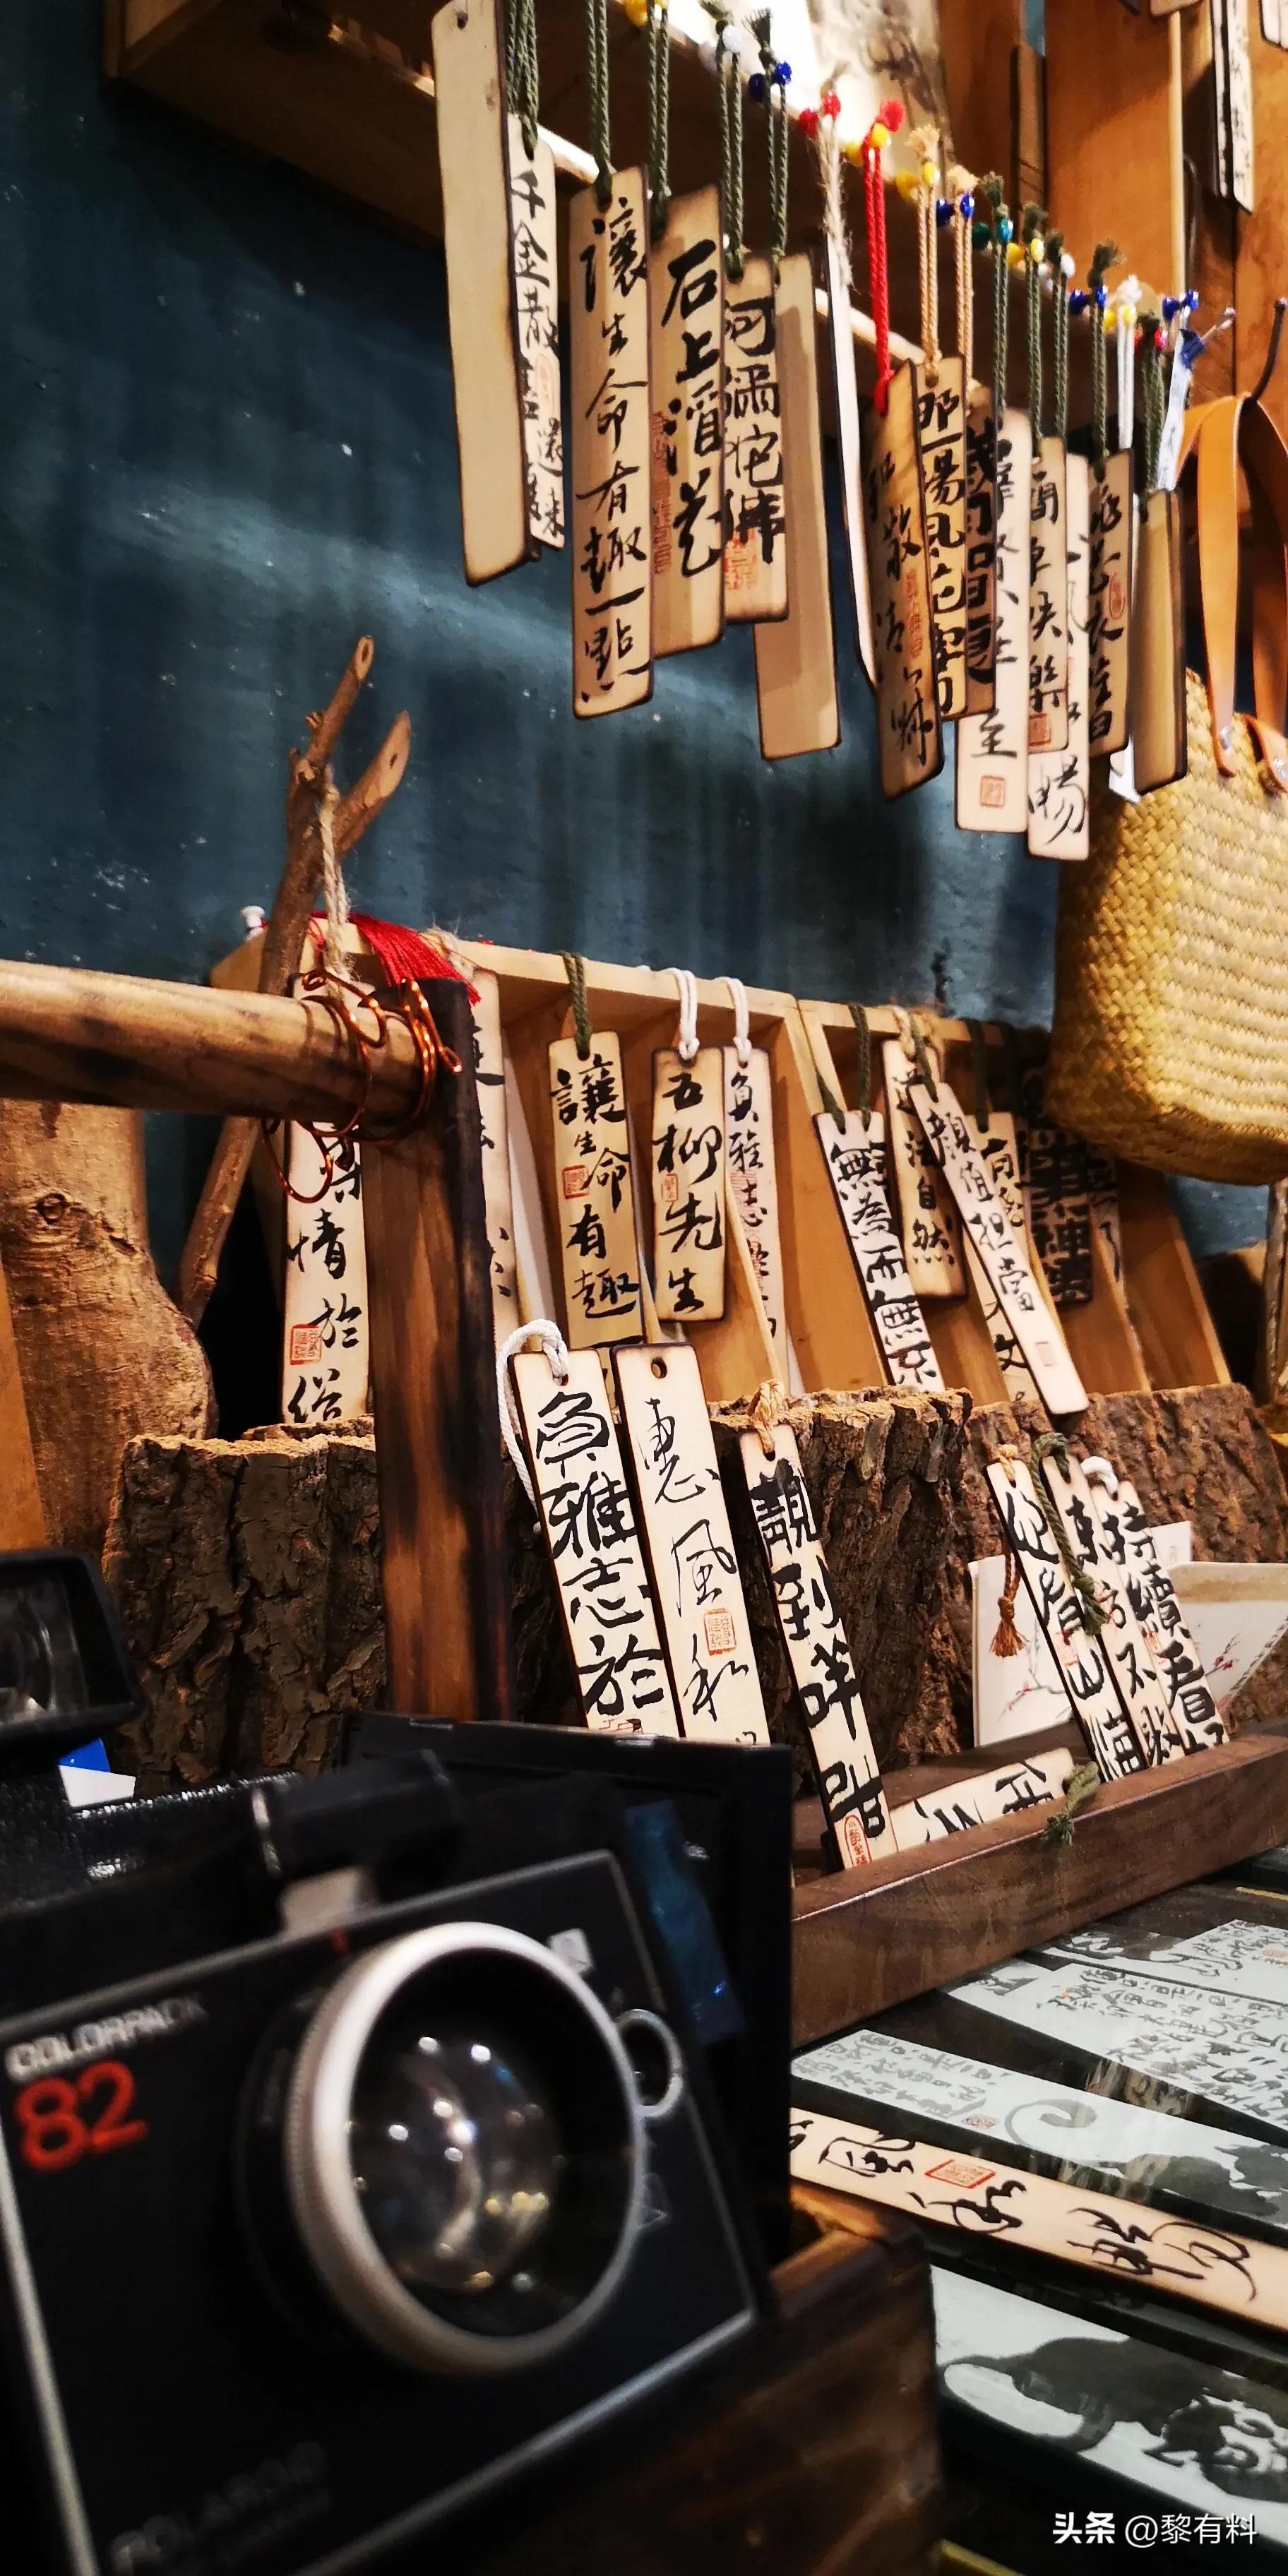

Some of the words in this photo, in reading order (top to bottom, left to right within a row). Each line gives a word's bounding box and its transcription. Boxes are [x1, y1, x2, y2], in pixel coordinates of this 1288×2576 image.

[651, 1073, 722, 1314] 五柳先生
[536, 1389, 664, 1731] 負雅志於
[638, 1397, 757, 1745] 惠風和
[14, 2060, 148, 2171] 82
